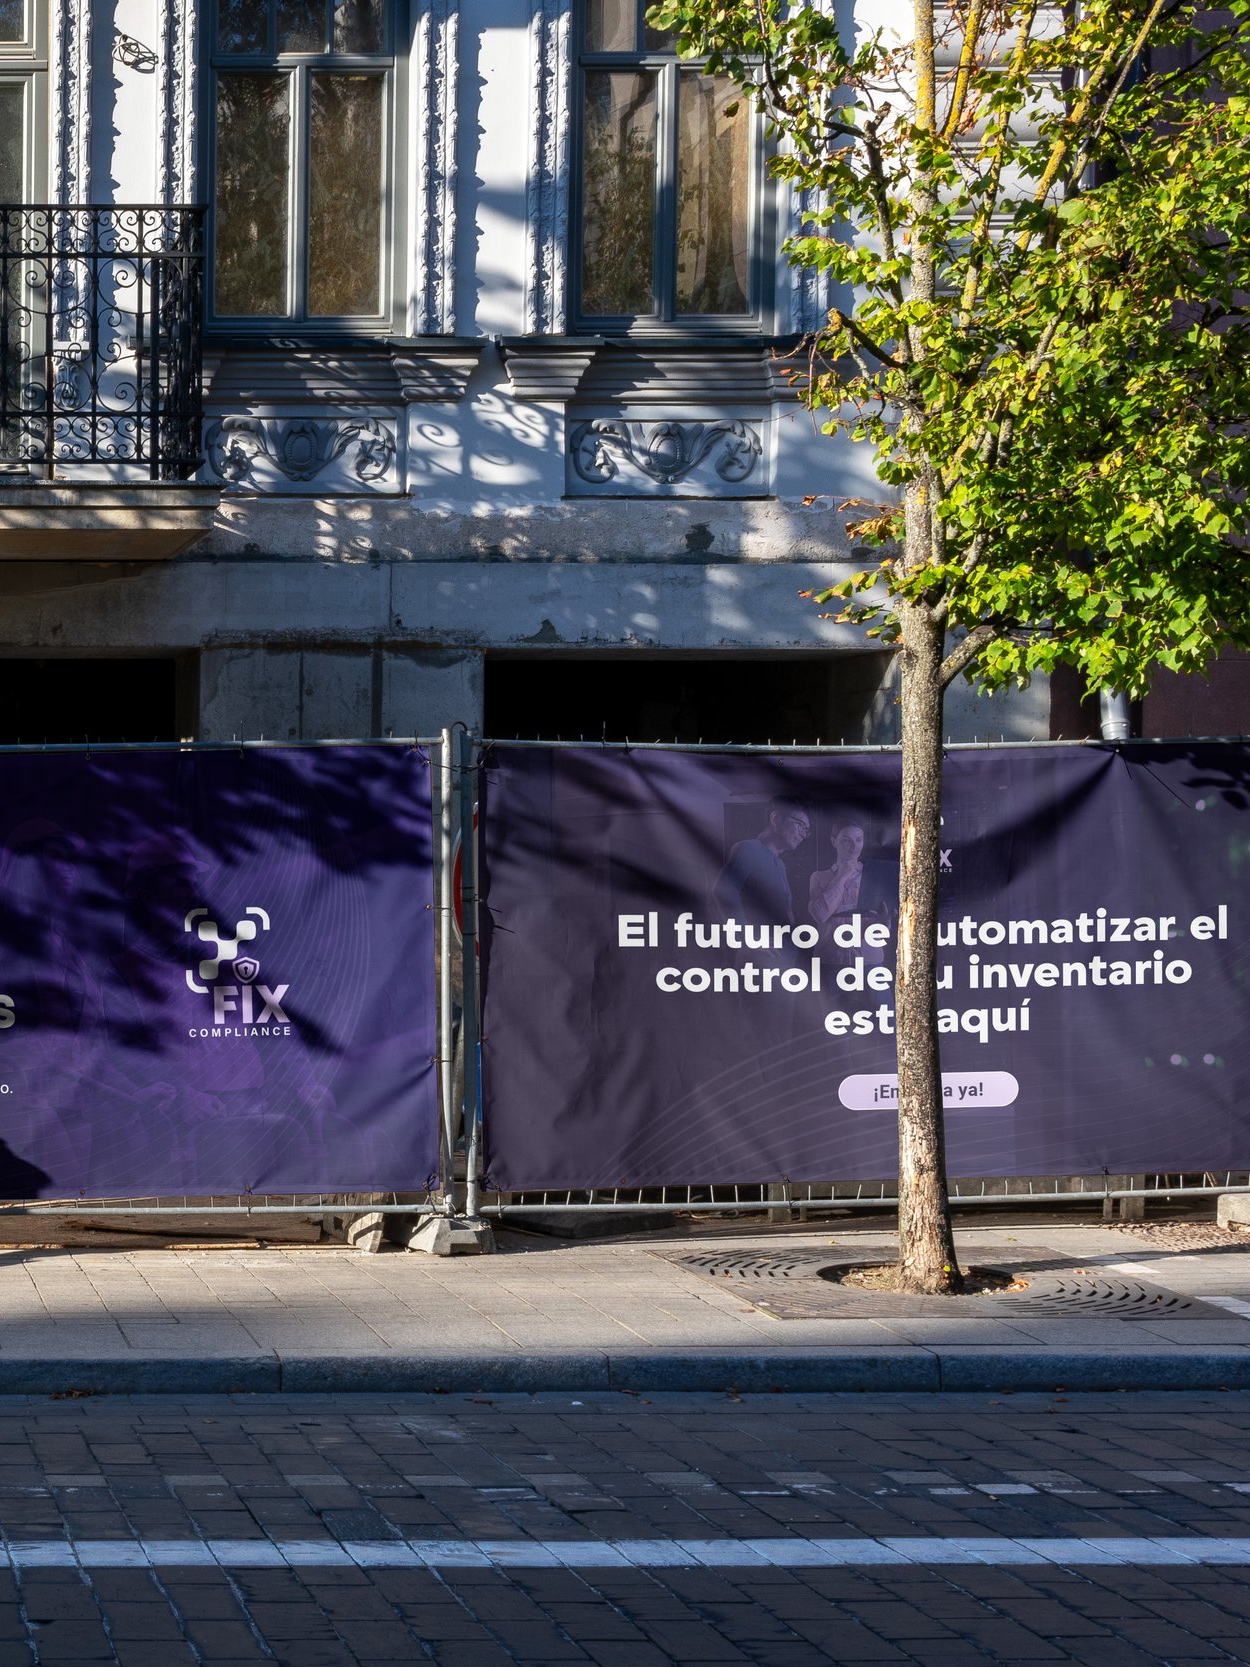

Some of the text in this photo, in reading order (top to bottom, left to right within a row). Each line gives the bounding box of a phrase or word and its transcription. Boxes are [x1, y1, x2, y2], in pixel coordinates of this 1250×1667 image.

[618, 904, 1229, 949] El futuro de utomatizar el
[655, 949, 1193, 993] control de u inventario
[213, 984, 291, 1025] FIX
[824, 997, 1031, 1044] est aquí
[188, 1026, 291, 1038] COMPLIANCE
[957, 1082, 984, 1101] ya!
